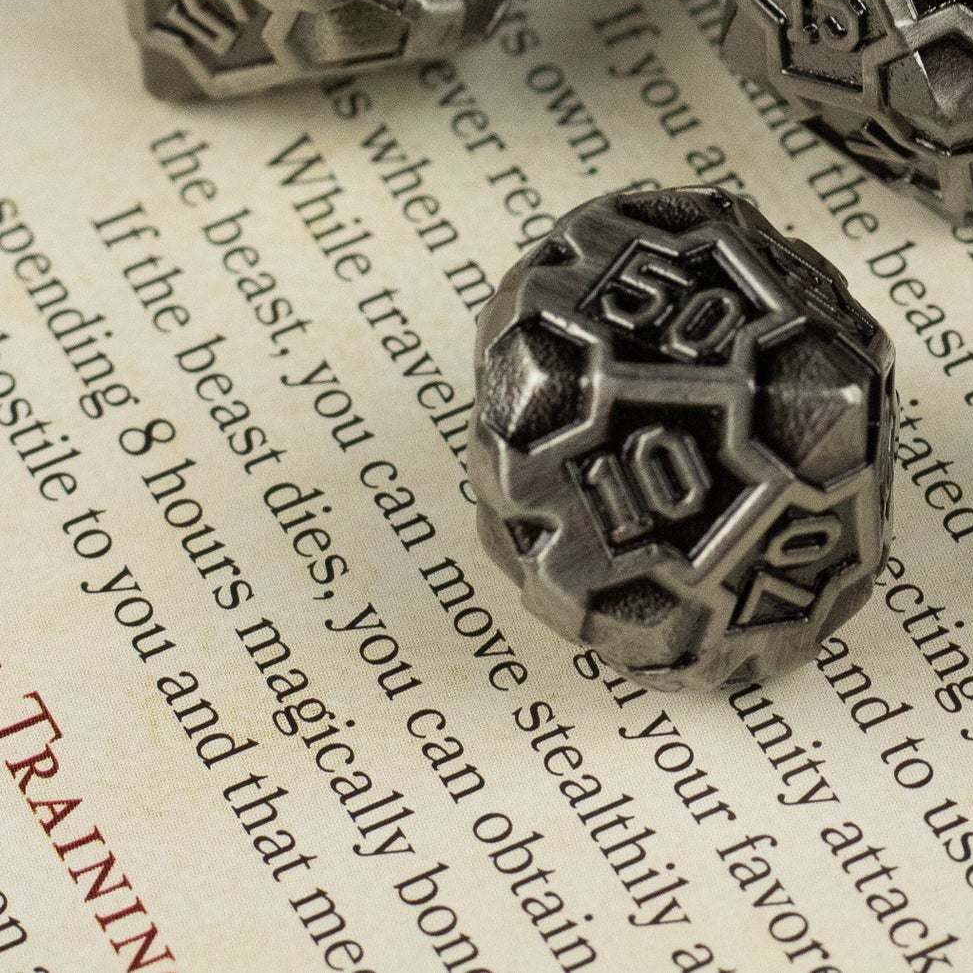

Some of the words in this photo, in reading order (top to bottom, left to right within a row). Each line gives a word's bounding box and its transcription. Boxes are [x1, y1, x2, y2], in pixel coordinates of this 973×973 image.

[526, 65, 611, 176] own,
[608, 53, 701, 139] you
[92, 203, 160, 248] If
[360, 123, 458, 253] when
[807, 164, 879, 239] the
[123, 256, 190, 332] the
[601, 255, 748, 362] 50
[119, 419, 176, 456] 8
[175, 335, 286, 475] beast
[150, 130, 217, 206] the
[202, 208, 311, 357] beast,
[280, 360, 374, 453] you
[360, 461, 436, 552] can
[419, 557, 528, 691] move
[512, 701, 690, 926] stealthily
[267, 132, 372, 281] While
[618, 710, 736, 824] your
[584, 426, 712, 543] 10
[63, 509, 112, 559] to
[142, 458, 254, 610] hours
[263, 483, 349, 600] dies,
[735, 514, 843, 627] 70
[81, 565, 176, 663] you
[325, 602, 422, 701] you
[157, 671, 259, 770] and
[235, 617, 415, 856] magically
[407, 709, 485, 804] can
[803, 638, 913, 734] and
[881, 737, 933, 789] to
[223, 773, 317, 882] that
[473, 813, 596, 973] obtain
